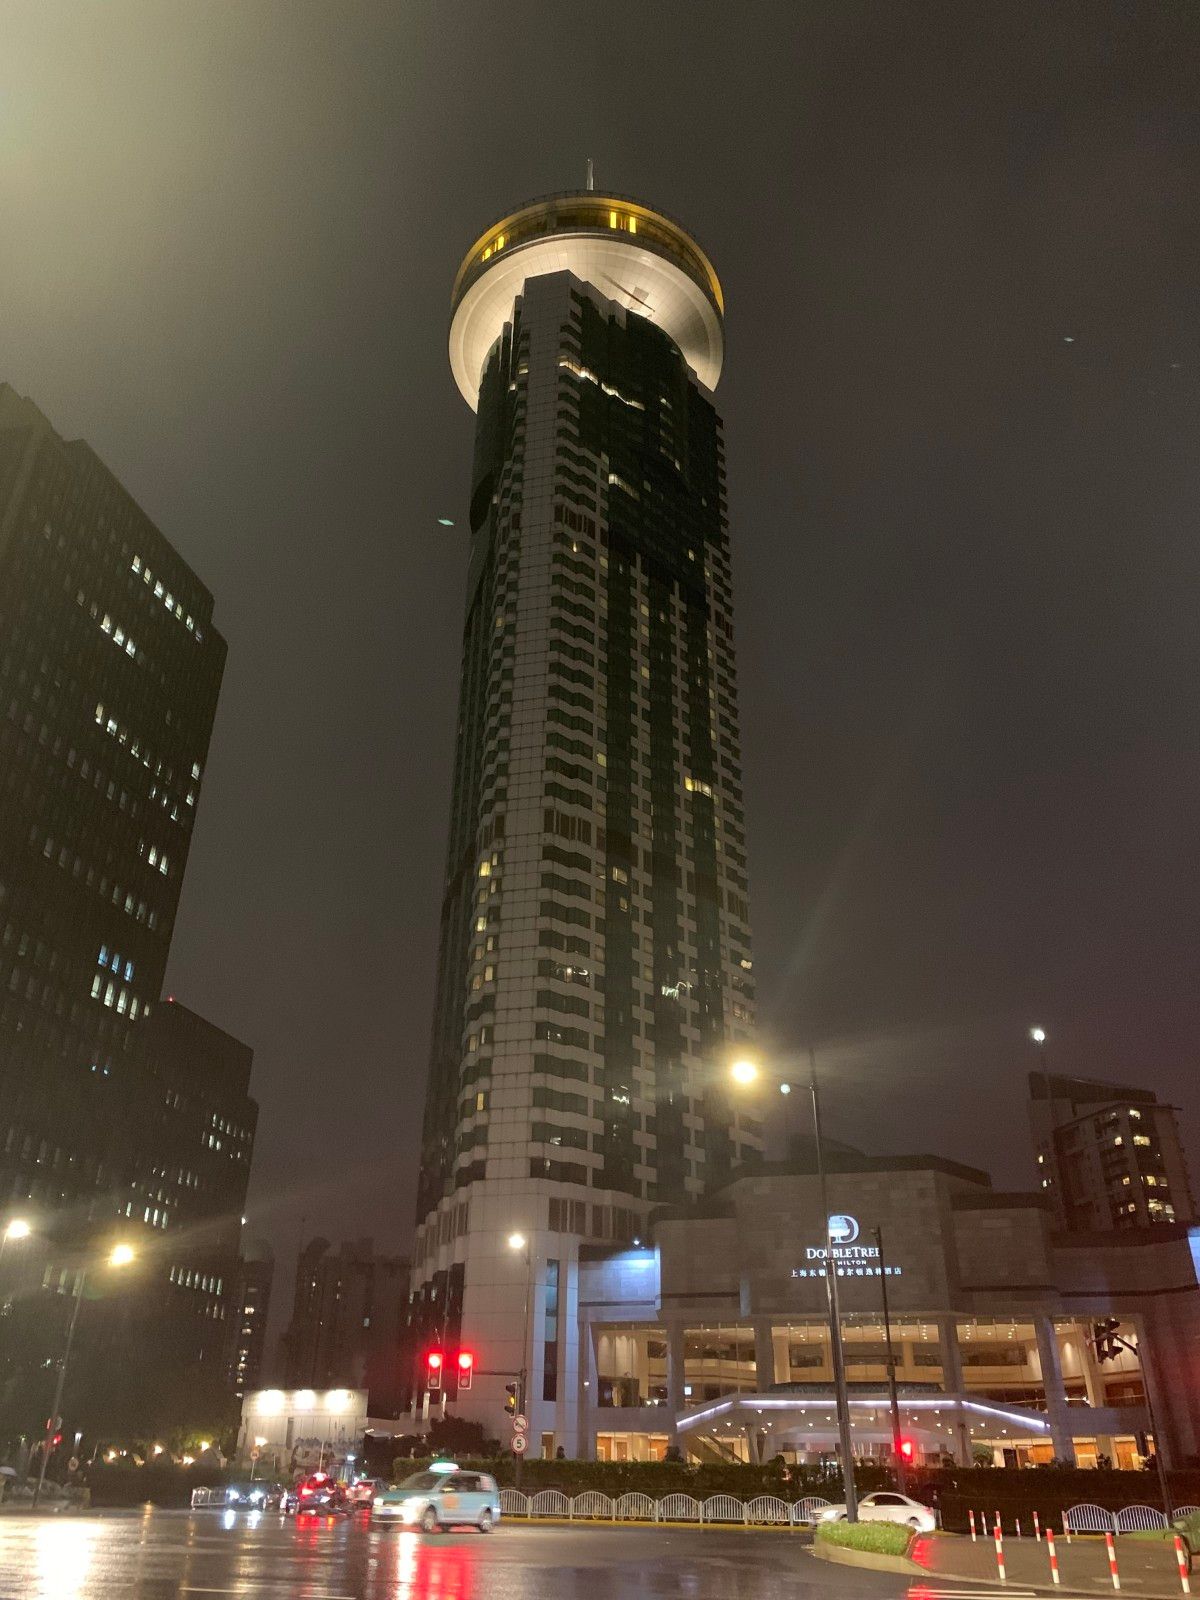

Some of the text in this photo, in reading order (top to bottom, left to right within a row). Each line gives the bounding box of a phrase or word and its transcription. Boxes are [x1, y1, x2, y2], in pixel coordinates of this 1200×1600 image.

[791, 1267, 902, 1278] 上海东锦希尔顿逸林酒店
